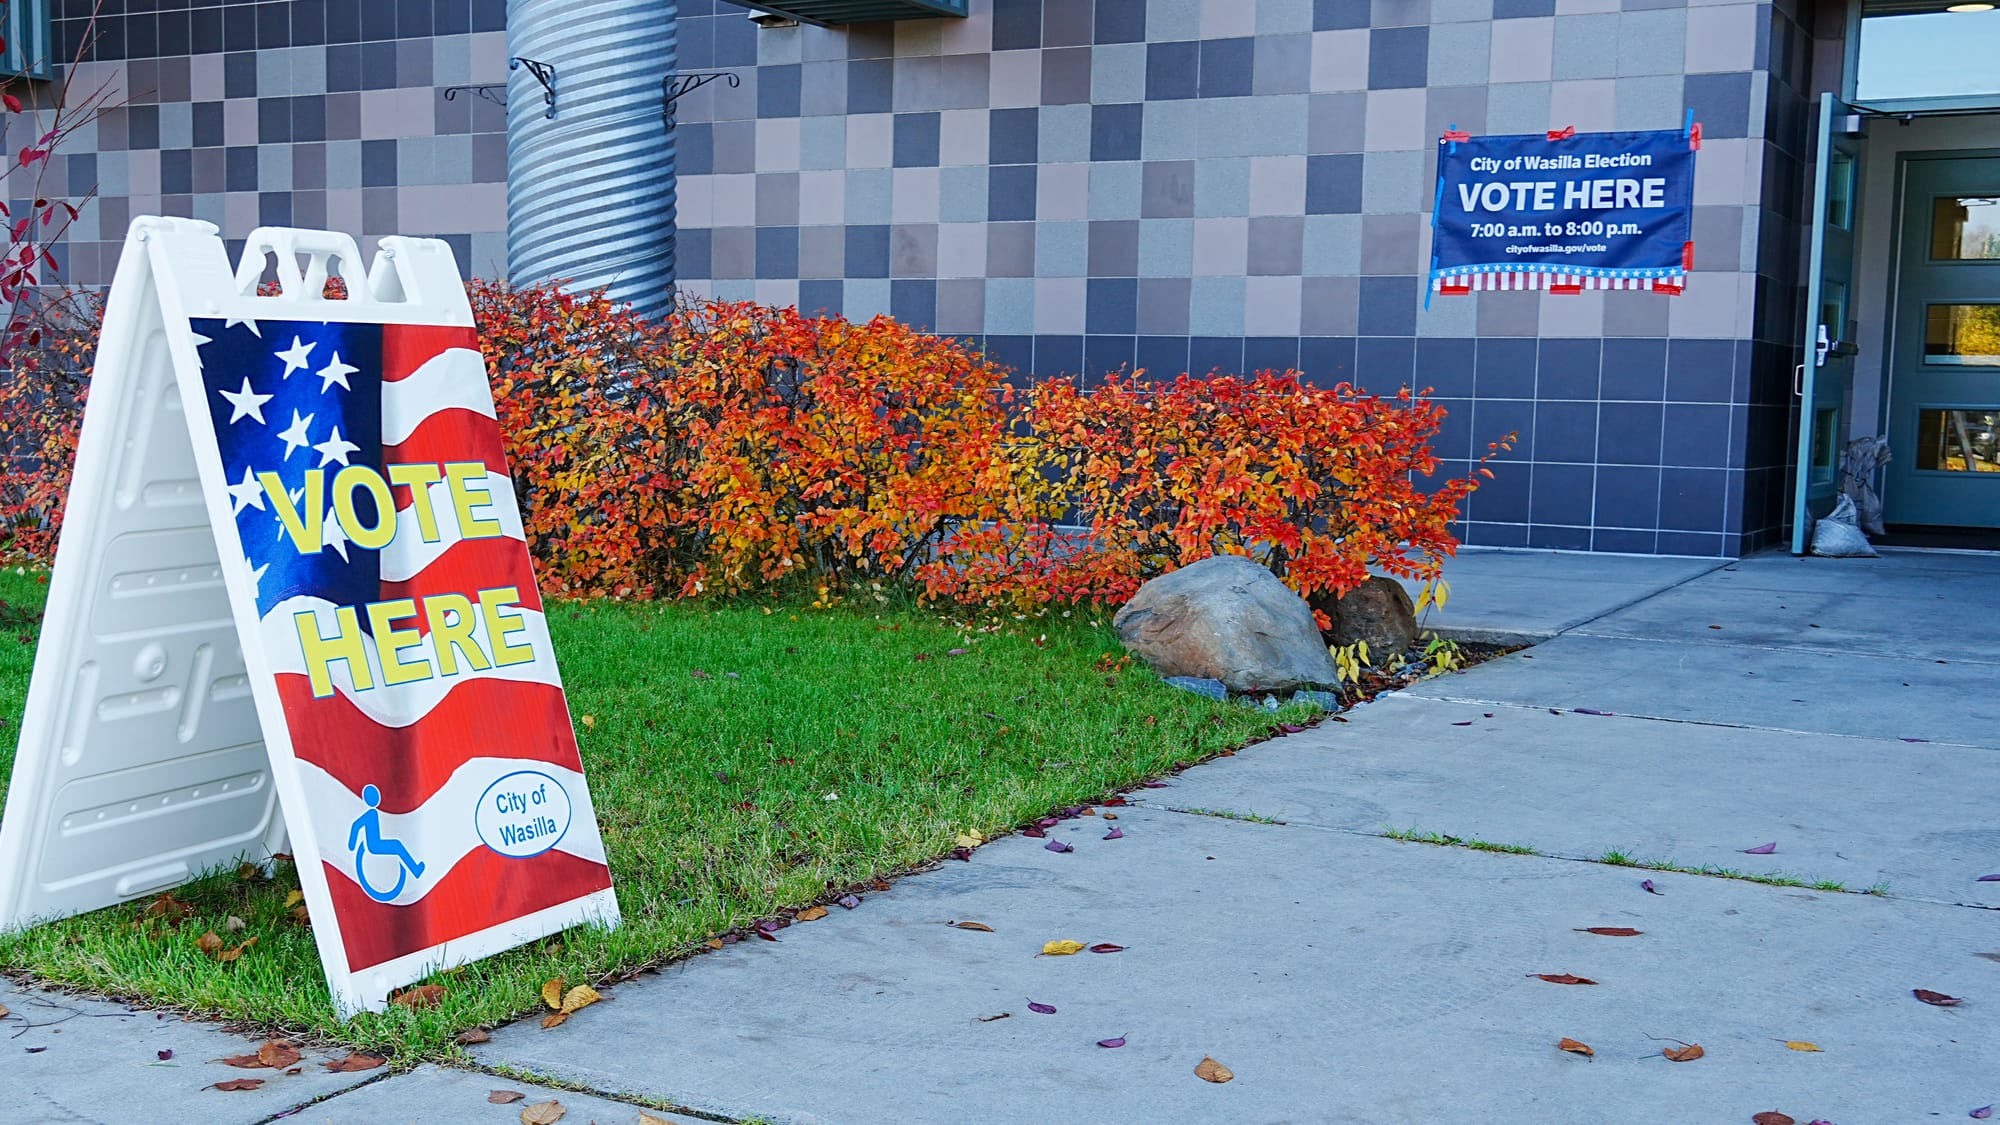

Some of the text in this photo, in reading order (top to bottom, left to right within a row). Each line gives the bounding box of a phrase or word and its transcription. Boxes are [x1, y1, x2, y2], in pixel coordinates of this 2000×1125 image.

[1470, 152, 1651, 173] City of Wasilla Election
[1458, 178, 1665, 211] VOTE HERE
[1470, 221, 1642, 238] 7:00 a.m. to 8:00 p.m.
[1505, 243, 1606, 254] cityofwasilla.gov/vote
[257, 461, 502, 553] VOTE
[293, 586, 534, 698] HERE
[496, 783, 546, 813] City of
[499, 815, 557, 846] Wasilla
